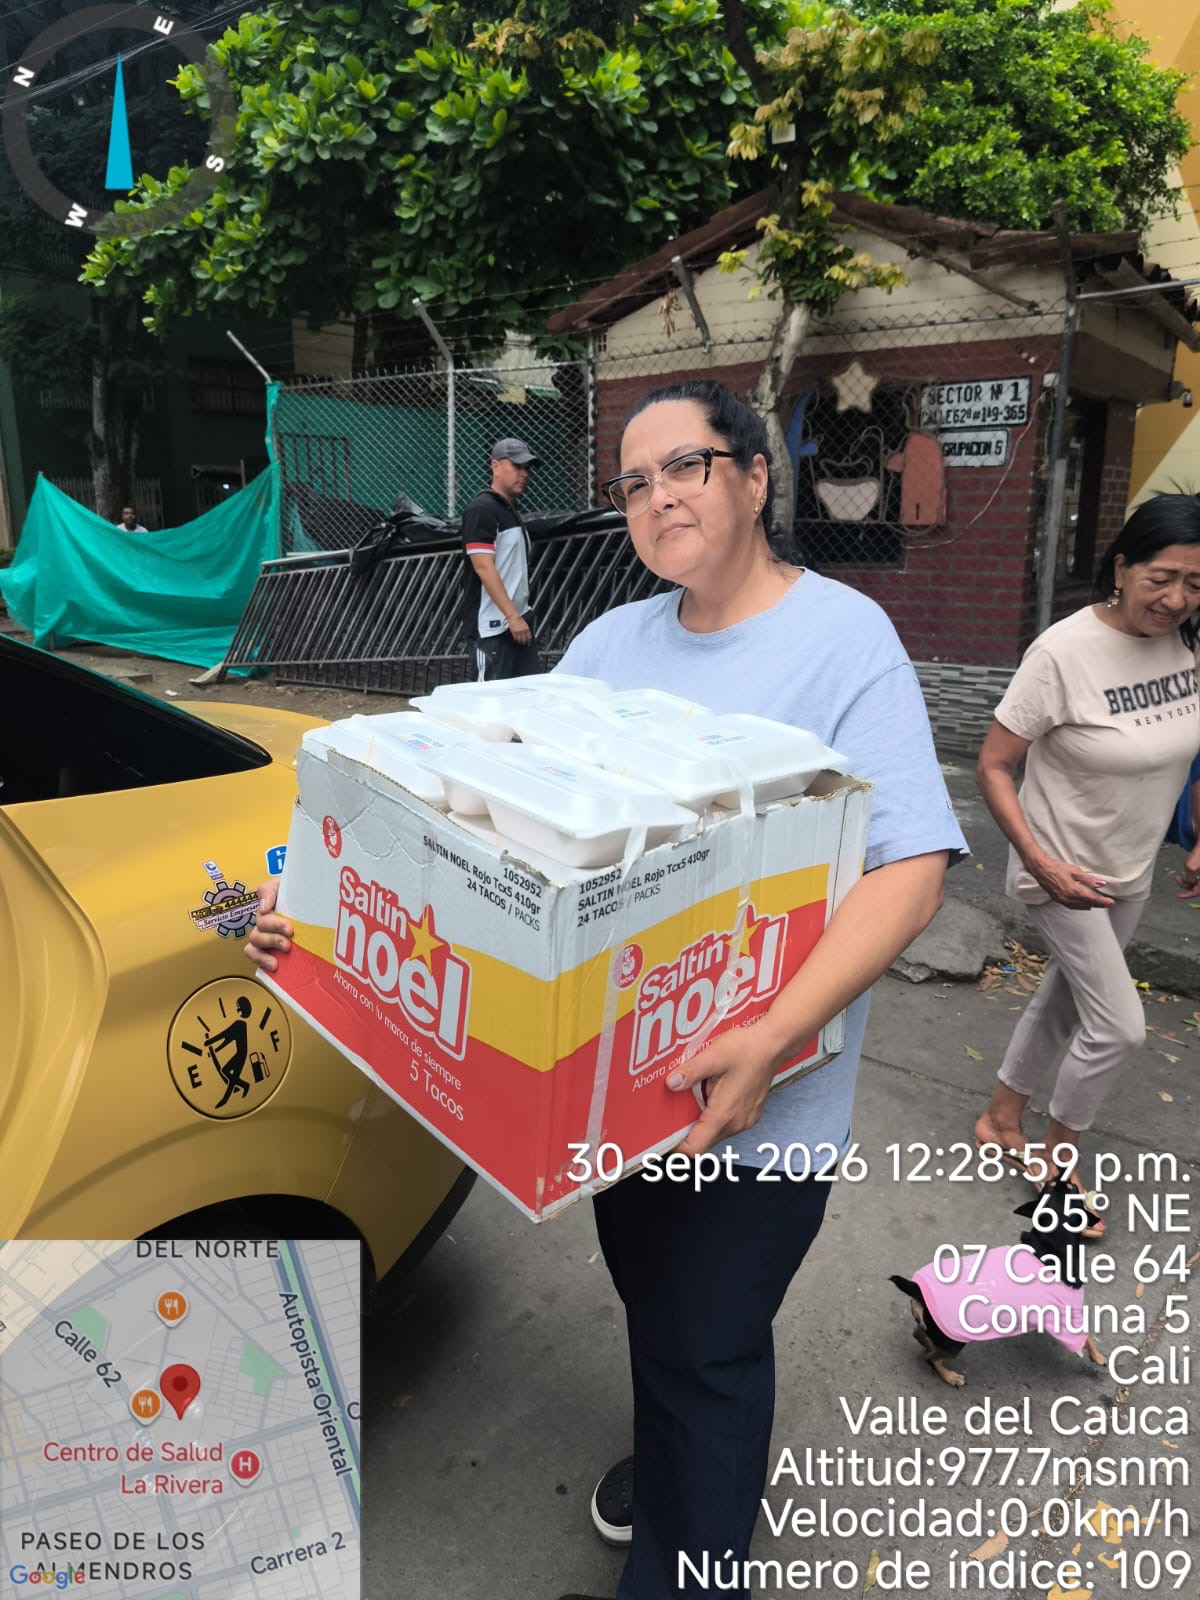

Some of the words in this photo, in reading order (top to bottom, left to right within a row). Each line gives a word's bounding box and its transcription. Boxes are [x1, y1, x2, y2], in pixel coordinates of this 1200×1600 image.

[927, 384, 983, 406] SECTOR
[1010, 381, 1022, 402] 1
[942, 440, 992, 457] GRUPACION
[1134, 713, 1162, 727] NEW
[423, 835, 449, 860] SALTIN
[450, 852, 471, 873] NOEL
[473, 865, 491, 885] Rojo
[514, 892, 541, 915] 410gr
[503, 867, 542, 898] 1052952
[578, 886, 615, 912] SALTIN
[616, 877, 642, 895] NOEL
[644, 868, 665, 884] Rojo
[687, 848, 710, 864] 410gr
[579, 868, 622, 895] 1052952
[467, 877, 477, 893] 24
[479, 884, 506, 910] TACOS
[515, 906, 541, 932] PACKS
[577, 913, 590, 928] 24
[592, 898, 625, 921] TACOS
[634, 883, 661, 903] PACKS
[336, 905, 464, 1048] noel
[635, 922, 781, 1066] noel
[270, 1029, 280, 1052] F
[333, 968, 358, 998] Ahorra
[359, 994, 374, 1013] con
[376, 1003, 383, 1021] tu
[384, 1015, 409, 1047] marca
[411, 1038, 423, 1057] de
[424, 1051, 461, 1091] siempre
[187, 1064, 202, 1089] E
[410, 1059, 419, 1081] 5
[423, 1068, 464, 1121] Tacos
[632, 1066, 666, 1093] Ahorra
